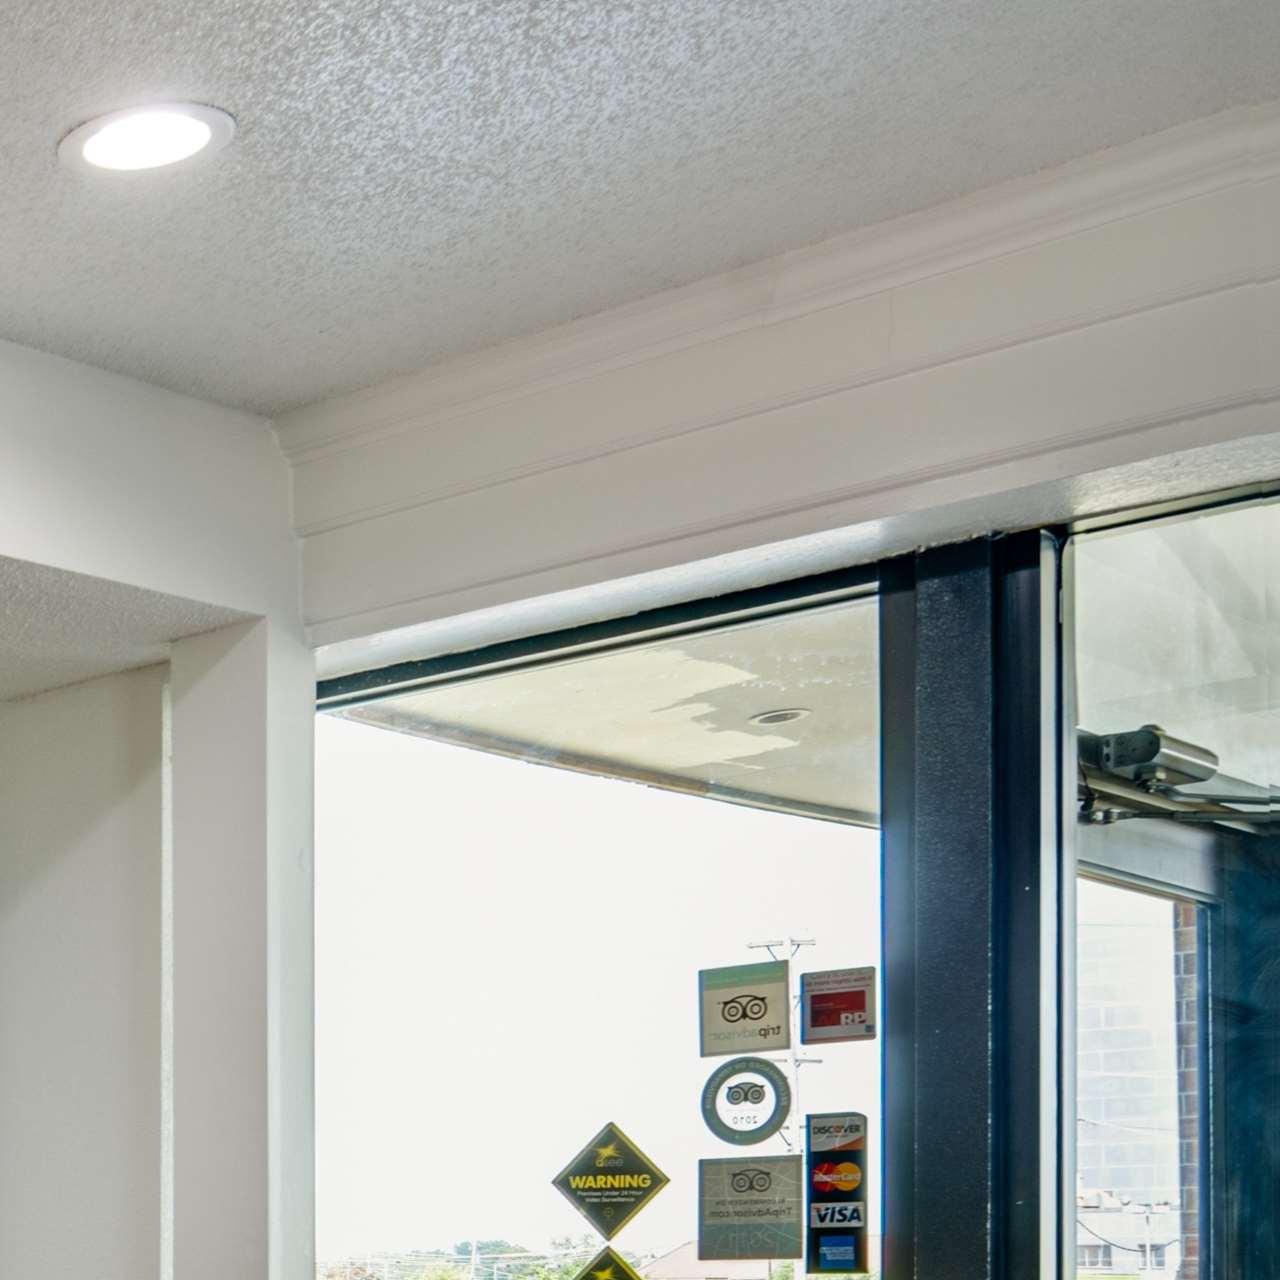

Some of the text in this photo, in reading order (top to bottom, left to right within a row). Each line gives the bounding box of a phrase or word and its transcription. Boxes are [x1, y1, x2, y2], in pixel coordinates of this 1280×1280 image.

[812, 1124, 861, 1135] DISCOVER
[569, 1174, 652, 1189] WARNING
[816, 1207, 862, 1223] VISA
